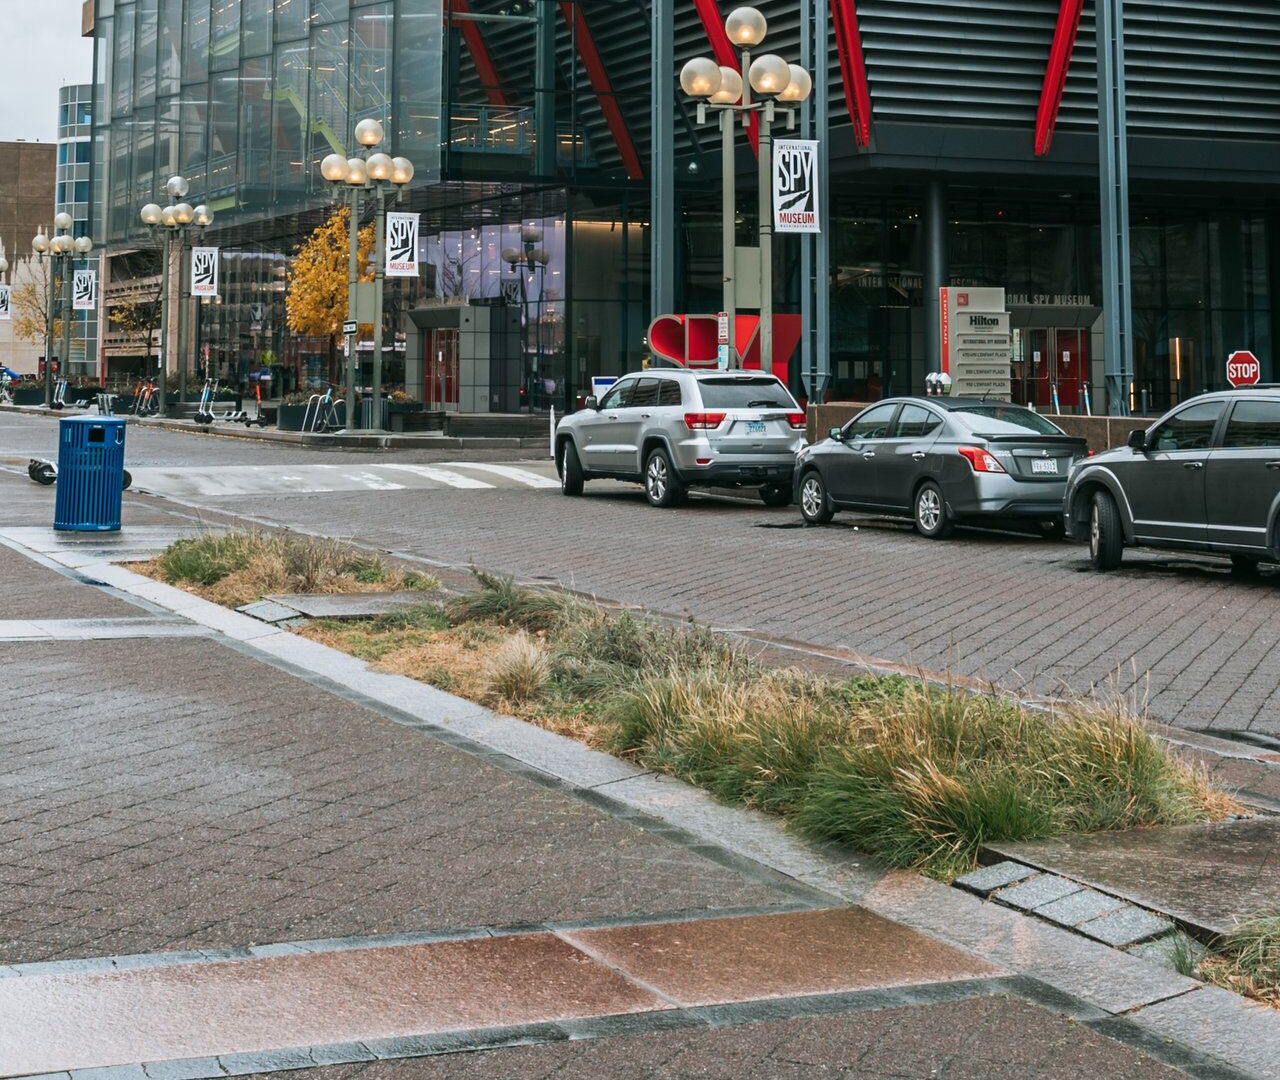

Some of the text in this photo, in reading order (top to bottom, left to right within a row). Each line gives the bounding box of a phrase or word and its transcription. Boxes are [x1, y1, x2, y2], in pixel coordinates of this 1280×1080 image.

[778, 151, 814, 192] SPY
[779, 213, 814, 224] MUSEUM
[390, 220, 415, 248] SPY
[195, 253, 215, 275] SPY
[390, 262, 414, 270] MUSEUM
[76, 274, 93, 292] SPY
[1033, 294, 1050, 305] SPY
[1054, 295, 1091, 305] MUSEUM
[969, 315, 999, 326] Hilton
[1229, 363, 1257, 378] STOP
